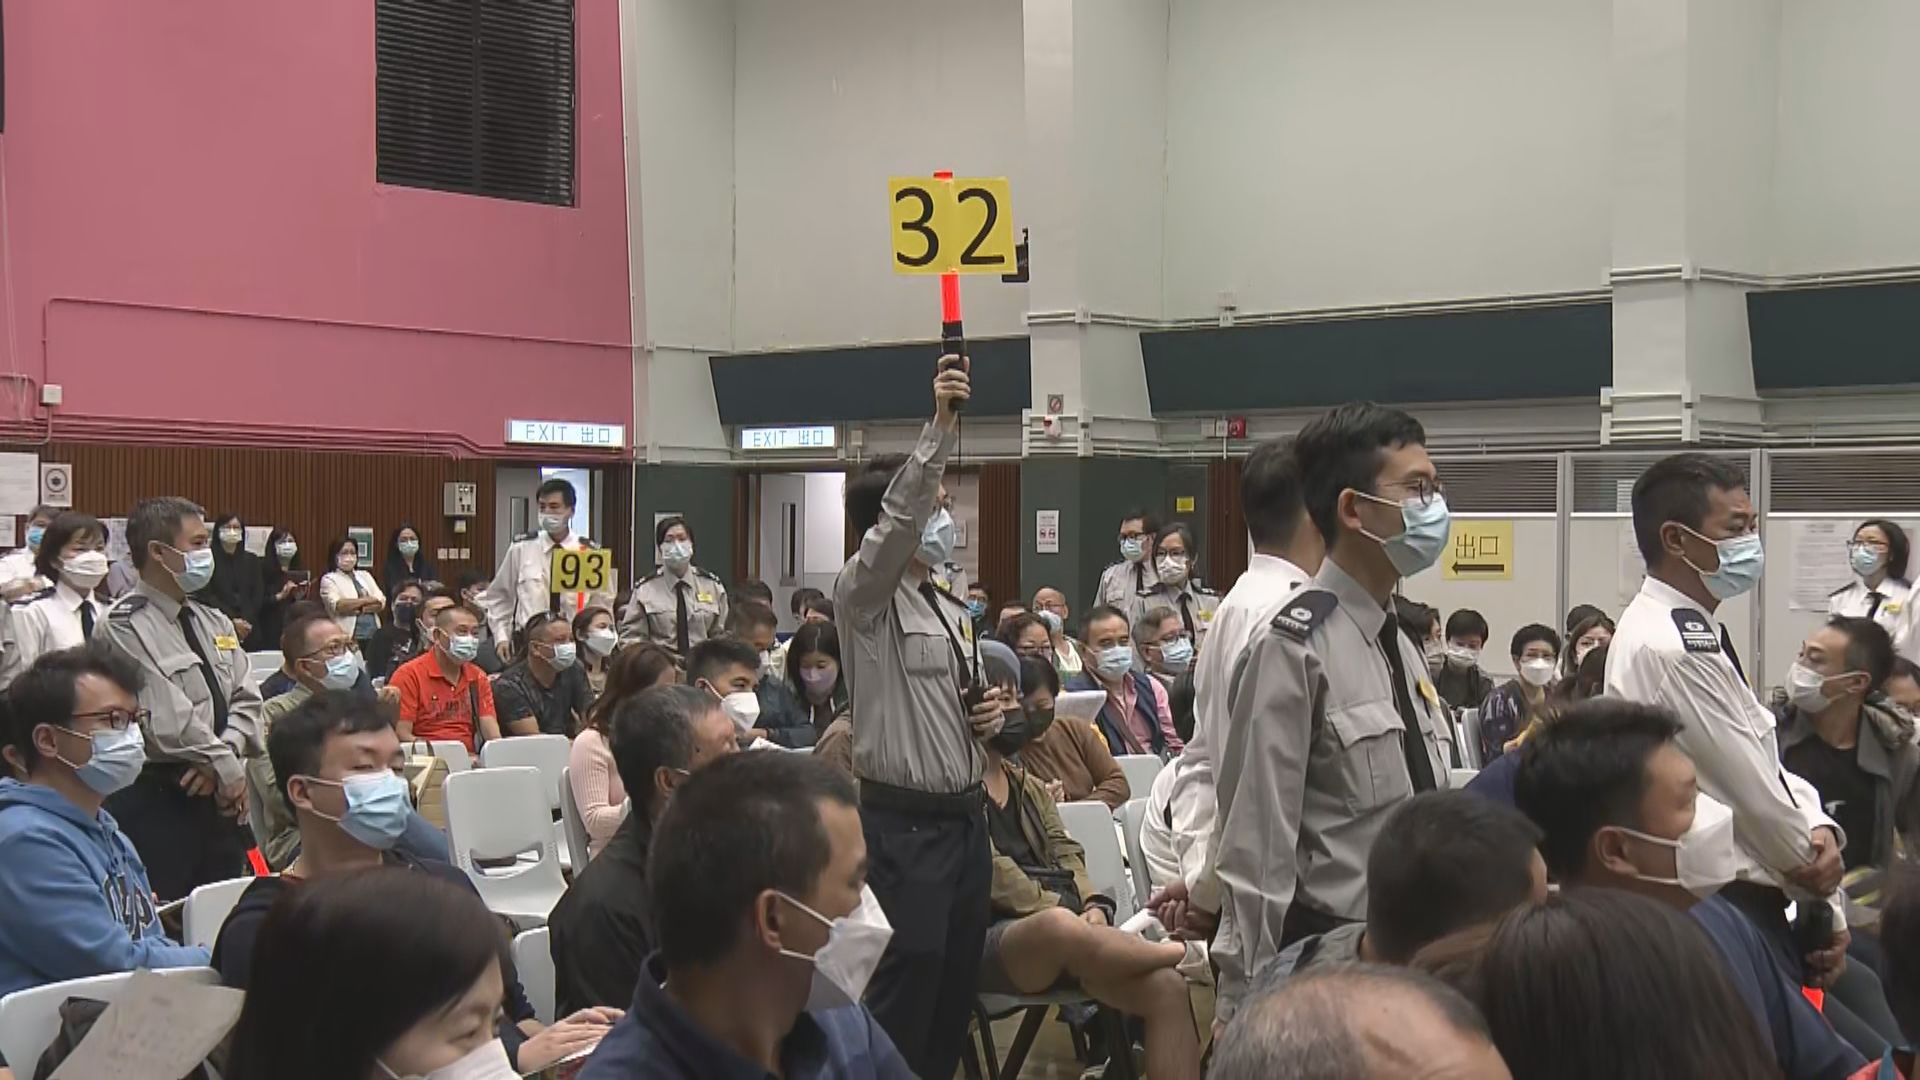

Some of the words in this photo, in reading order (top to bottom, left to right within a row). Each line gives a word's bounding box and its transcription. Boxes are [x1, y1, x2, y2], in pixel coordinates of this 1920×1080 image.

[895, 186, 1005, 267] 32
[526, 423, 567, 441] EXIT
[581, 426, 610, 443] 出口
[753, 431, 787, 447] EXIT
[798, 430, 823, 445] 出口
[1455, 533, 1498, 560] 出口
[561, 553, 604, 589] 93
